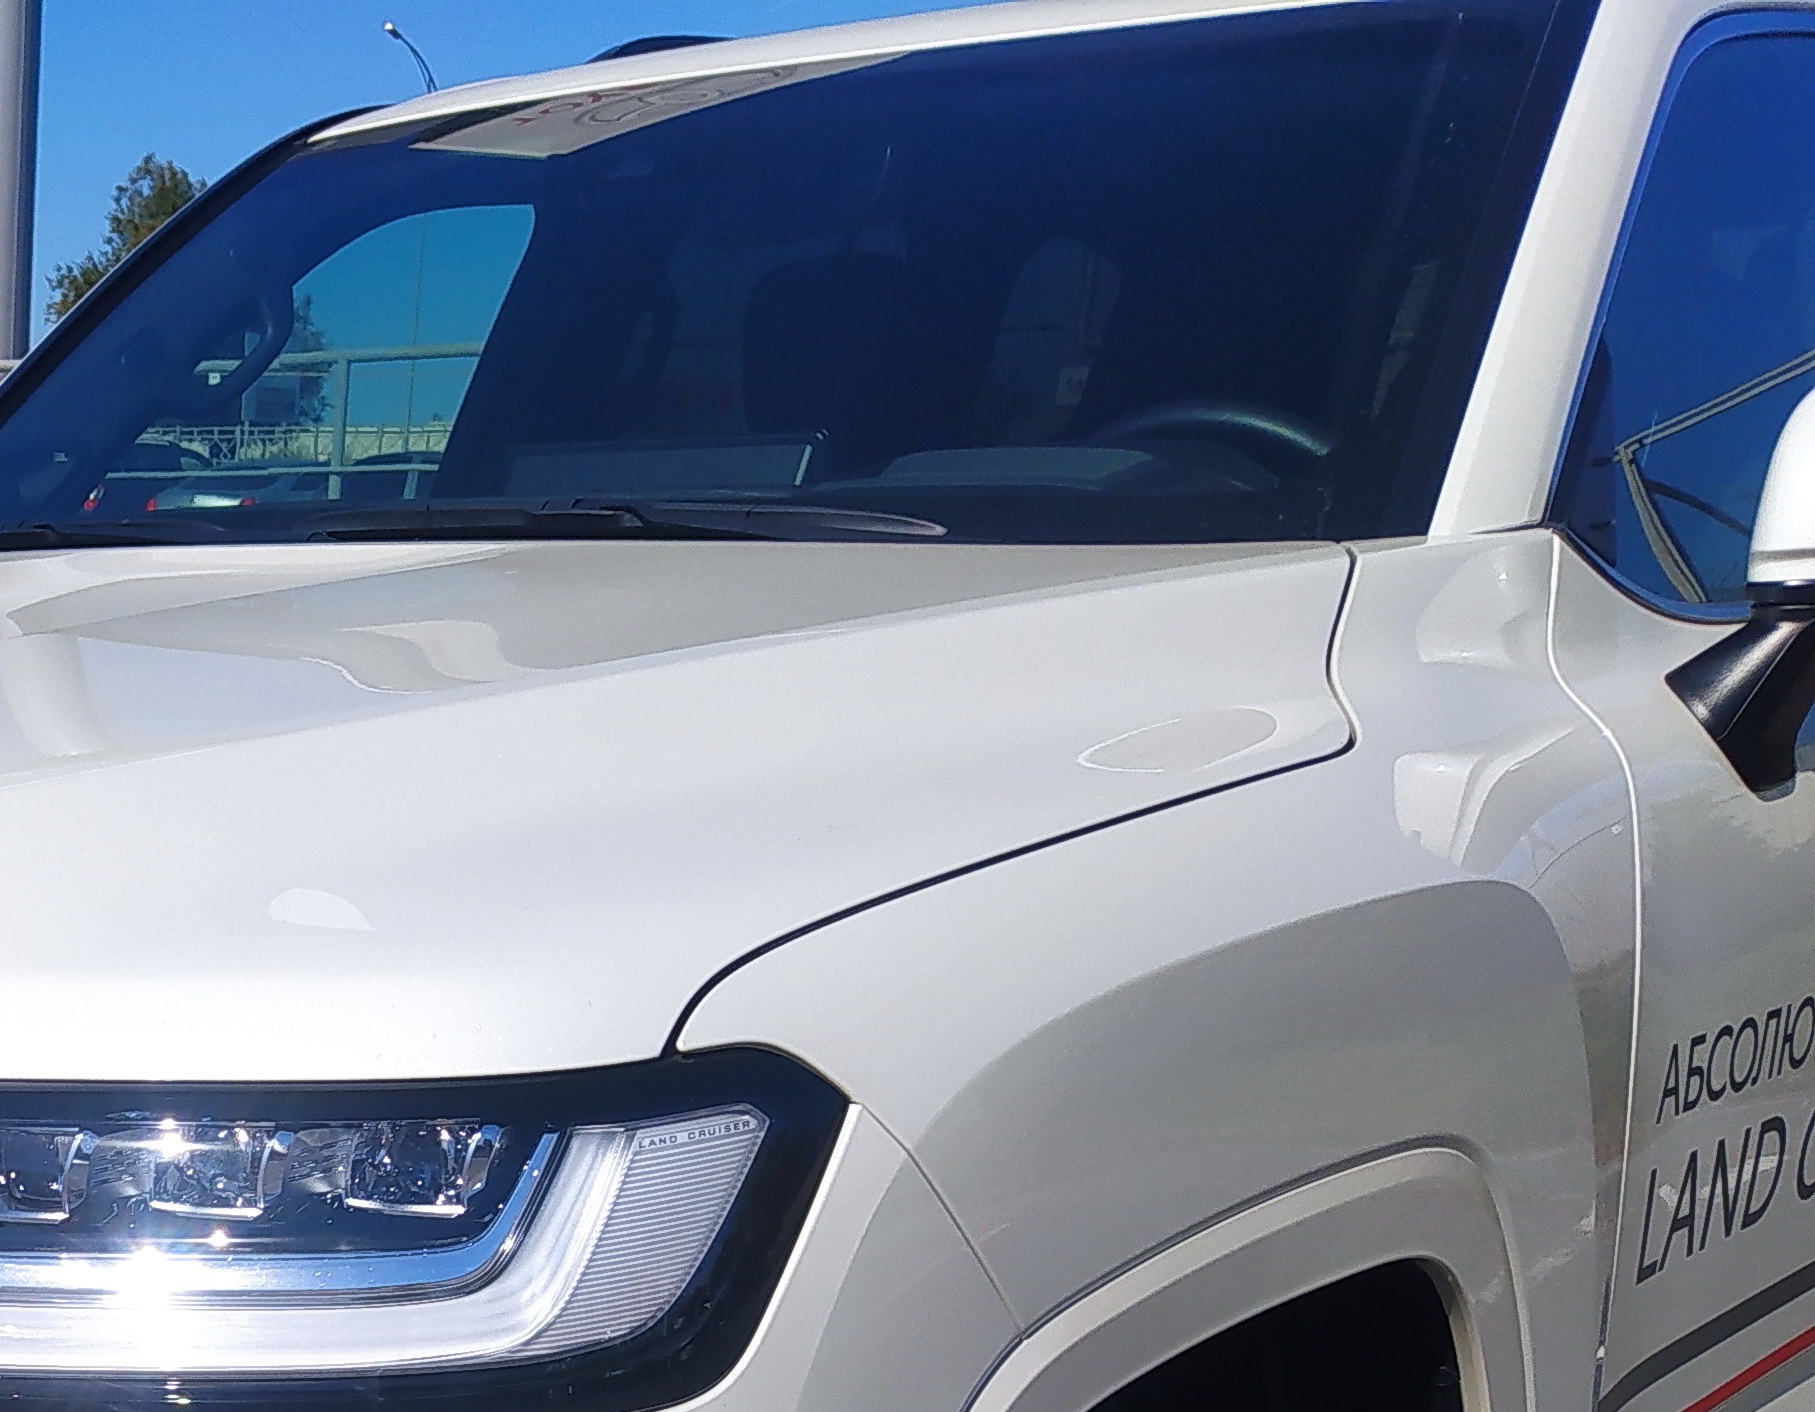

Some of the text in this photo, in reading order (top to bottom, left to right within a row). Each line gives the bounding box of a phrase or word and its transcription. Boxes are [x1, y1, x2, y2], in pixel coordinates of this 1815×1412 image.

[638, 1120, 751, 1149] LAND CRUISER
[1634, 1115, 1786, 1288] LAND
